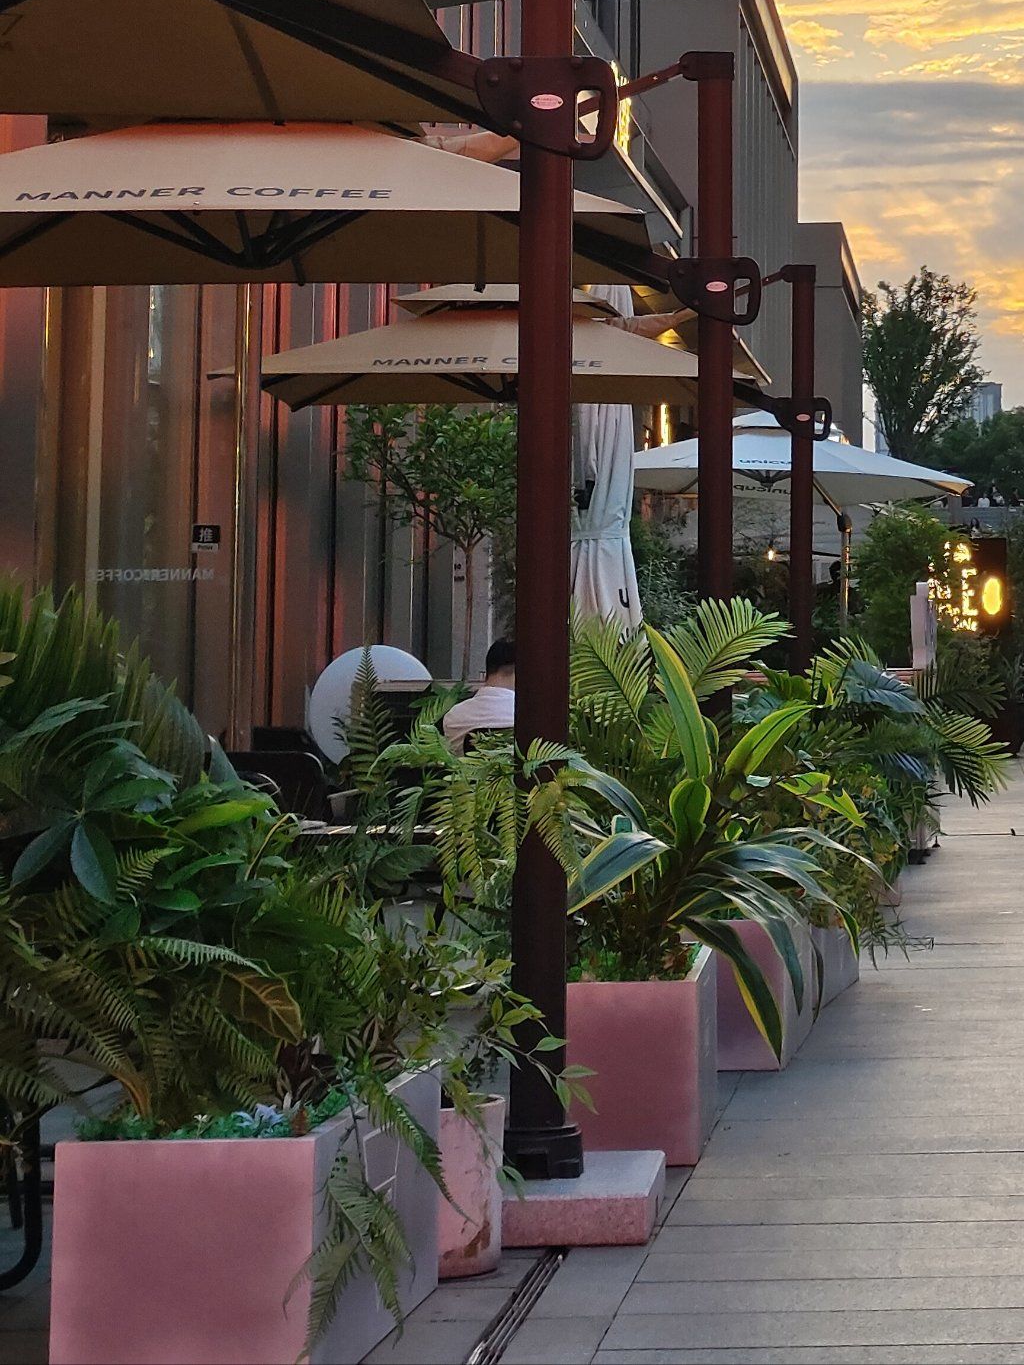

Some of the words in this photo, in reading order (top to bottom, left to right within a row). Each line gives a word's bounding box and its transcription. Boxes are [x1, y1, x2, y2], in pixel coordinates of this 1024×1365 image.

[15, 185, 206, 202] MANNER
[226, 185, 393, 200] COFFEE
[371, 355, 489, 367] MANNER
[501, 357, 604, 368] CEE
[198, 526, 214, 543] 推
